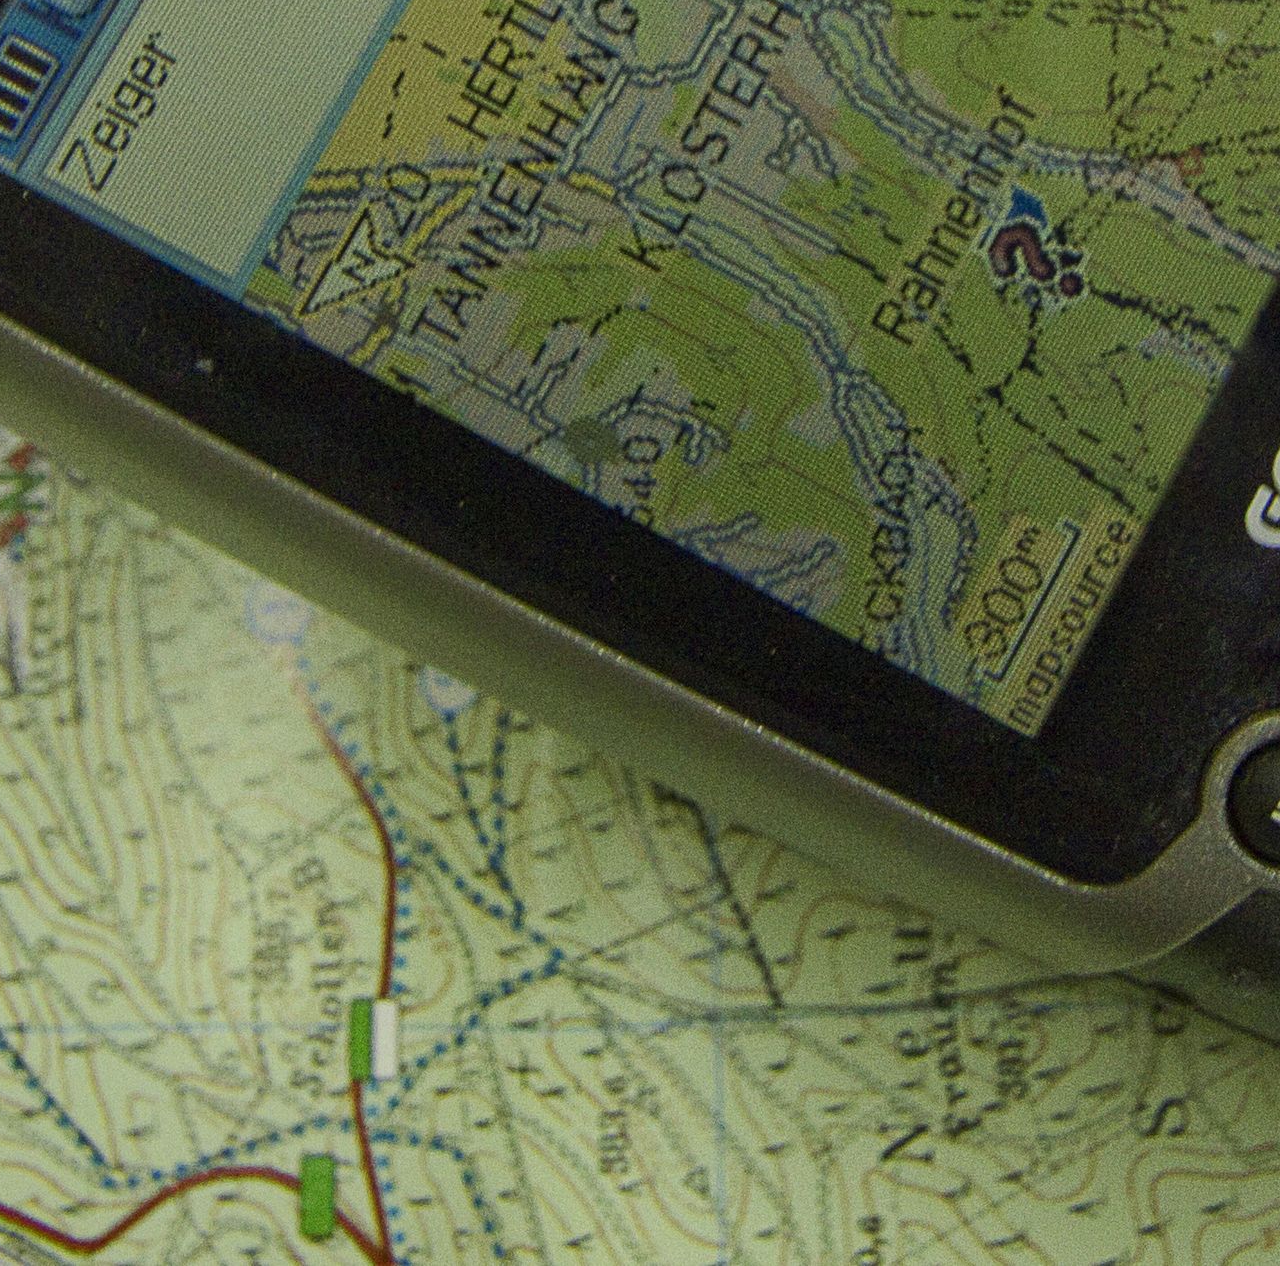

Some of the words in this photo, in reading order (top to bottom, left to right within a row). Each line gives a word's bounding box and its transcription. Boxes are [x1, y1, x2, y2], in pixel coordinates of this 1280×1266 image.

[61, 29, 181, 192] Zeiger
[873, 88, 1036, 345] Rahnenhof
[1010, 519, 1132, 728] mapsource
